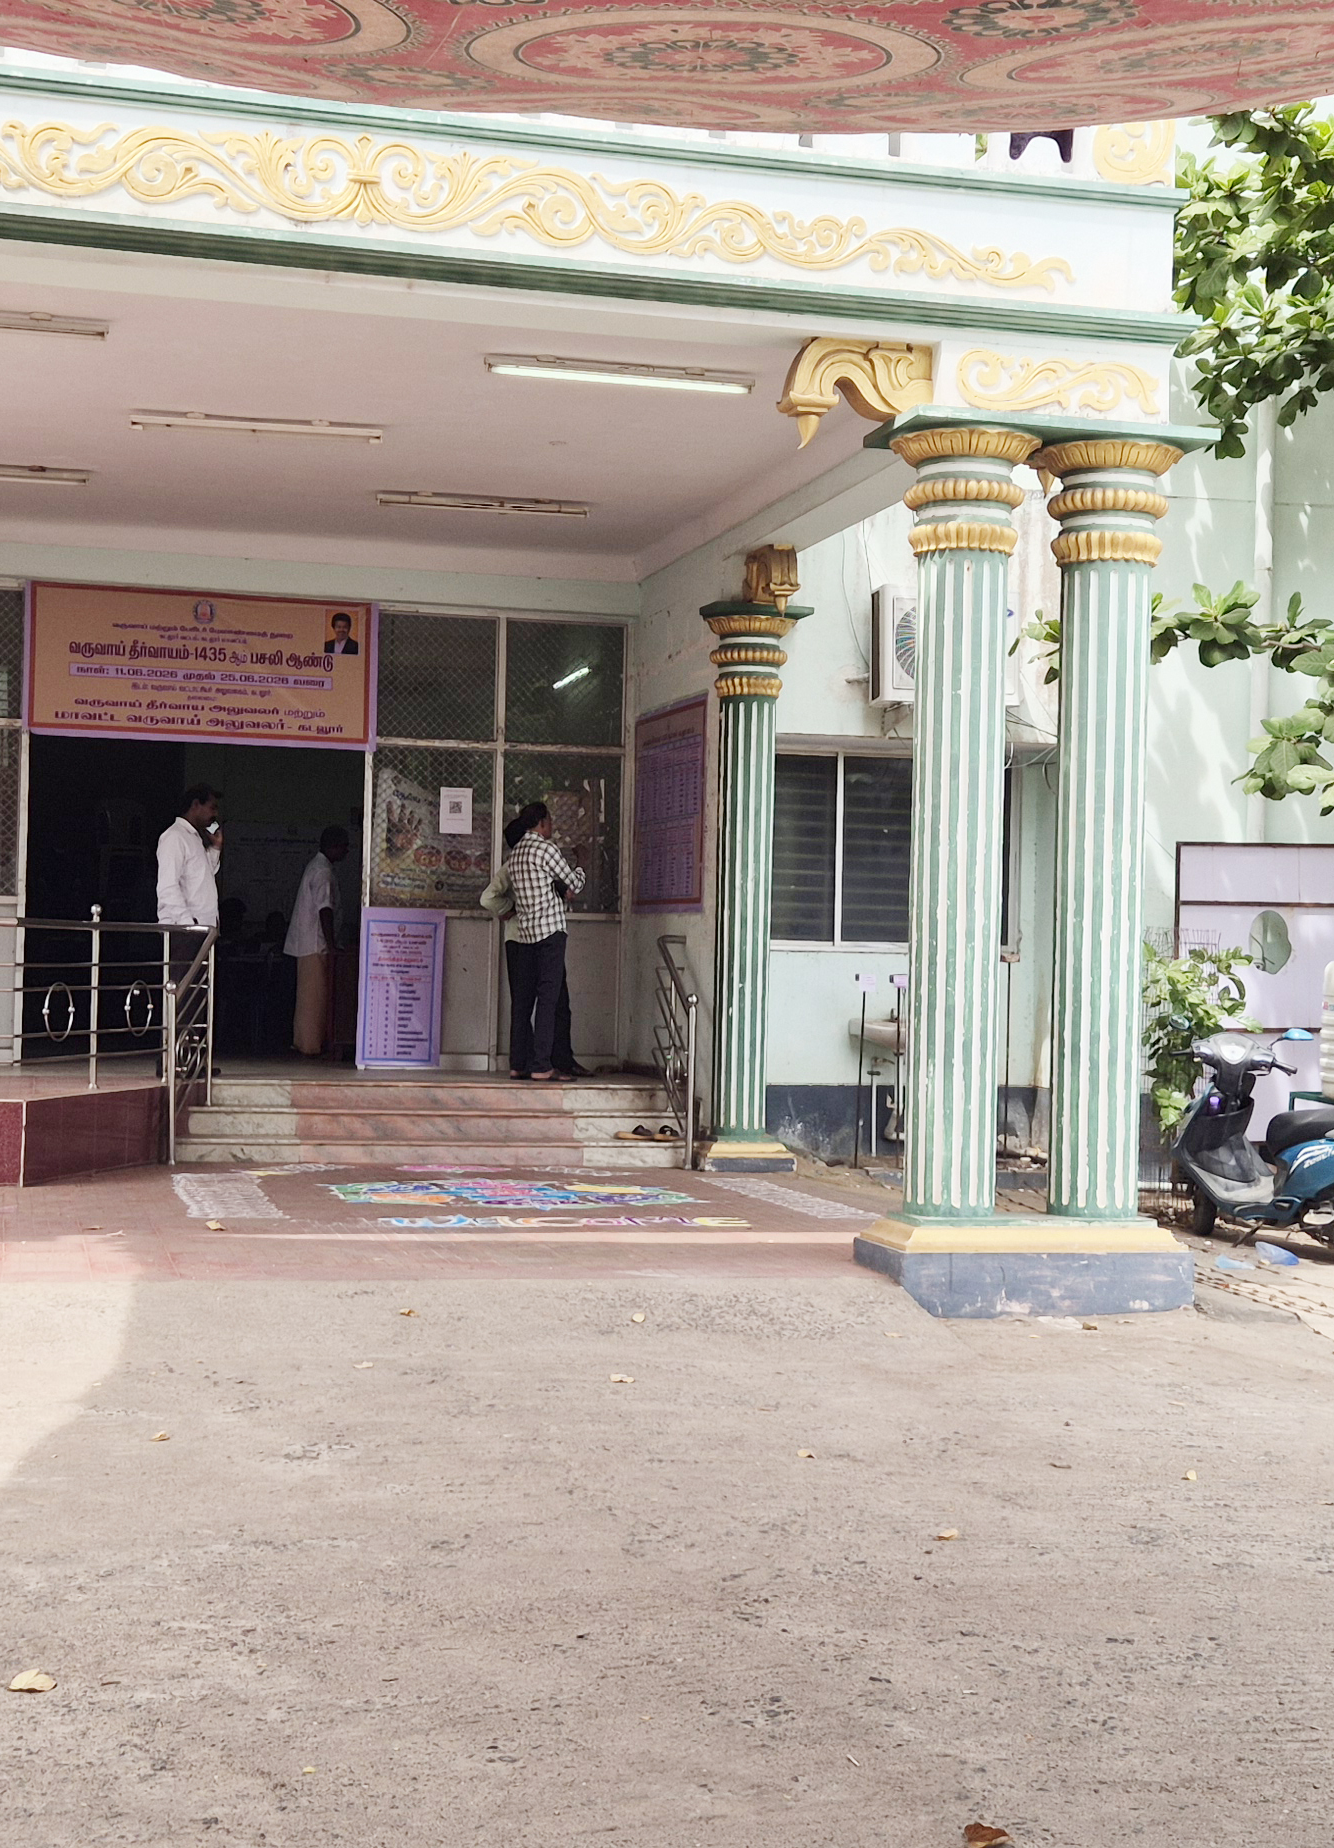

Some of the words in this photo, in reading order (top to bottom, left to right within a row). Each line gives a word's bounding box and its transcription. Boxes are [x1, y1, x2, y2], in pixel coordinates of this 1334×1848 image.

[69, 640, 126, 658] வருவாய்
[229, 649, 247, 666] ஆம்
[250, 650, 283, 666] பசலி
[286, 652, 334, 672] ஆண்டு
[76, 665, 109, 675] நாள்:
[182, 671, 216, 682] முதல்
[293, 678, 325, 688] வரை
[74, 697, 142, 708] வருவாய்
[146, 700, 205, 711] தீர்வாய
[209, 704, 279, 716] அலுவலர்
[284, 708, 325, 720] மற்றும்
[54, 710, 121, 722] மாவட்ட
[126, 714, 201, 726] வருவாய்
[298, 724, 344, 735] கடலூர்
